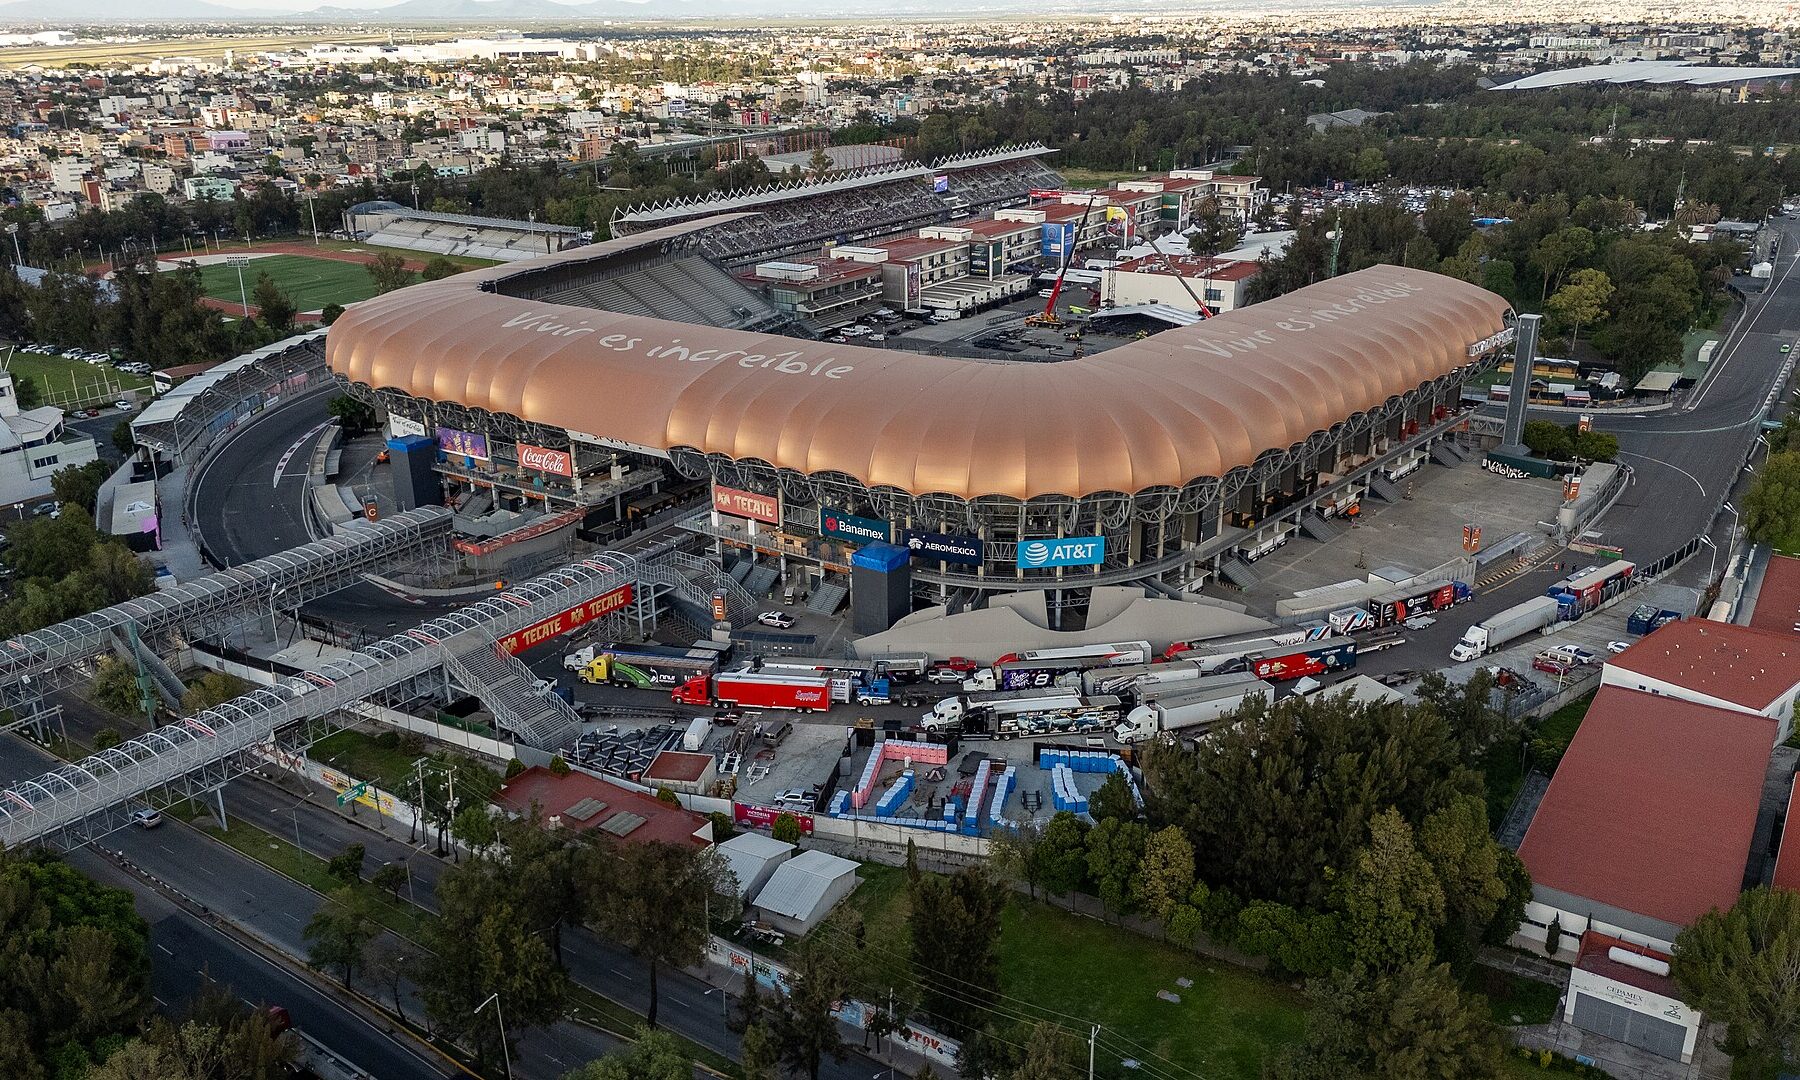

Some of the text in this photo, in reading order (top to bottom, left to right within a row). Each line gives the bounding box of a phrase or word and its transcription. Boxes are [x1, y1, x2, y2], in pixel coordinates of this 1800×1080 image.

[502, 311, 854, 379] Vivir es increíble
[1184, 330, 1276, 359] Vivir
[1275, 316, 1316, 332] es
[523, 448, 566, 473] Coca-Cola
[1570, 486, 1578, 495] F
[368, 508, 377, 517] C
[734, 495, 774, 518] TECATE
[839, 520, 884, 541] Banamex
[1471, 537, 1479, 547] F
[1052, 543, 1098, 561] AT&T
[522, 589, 626, 646] TECATE TECATE
[714, 605, 723, 615] E
[1034, 673, 1050, 686] 8
